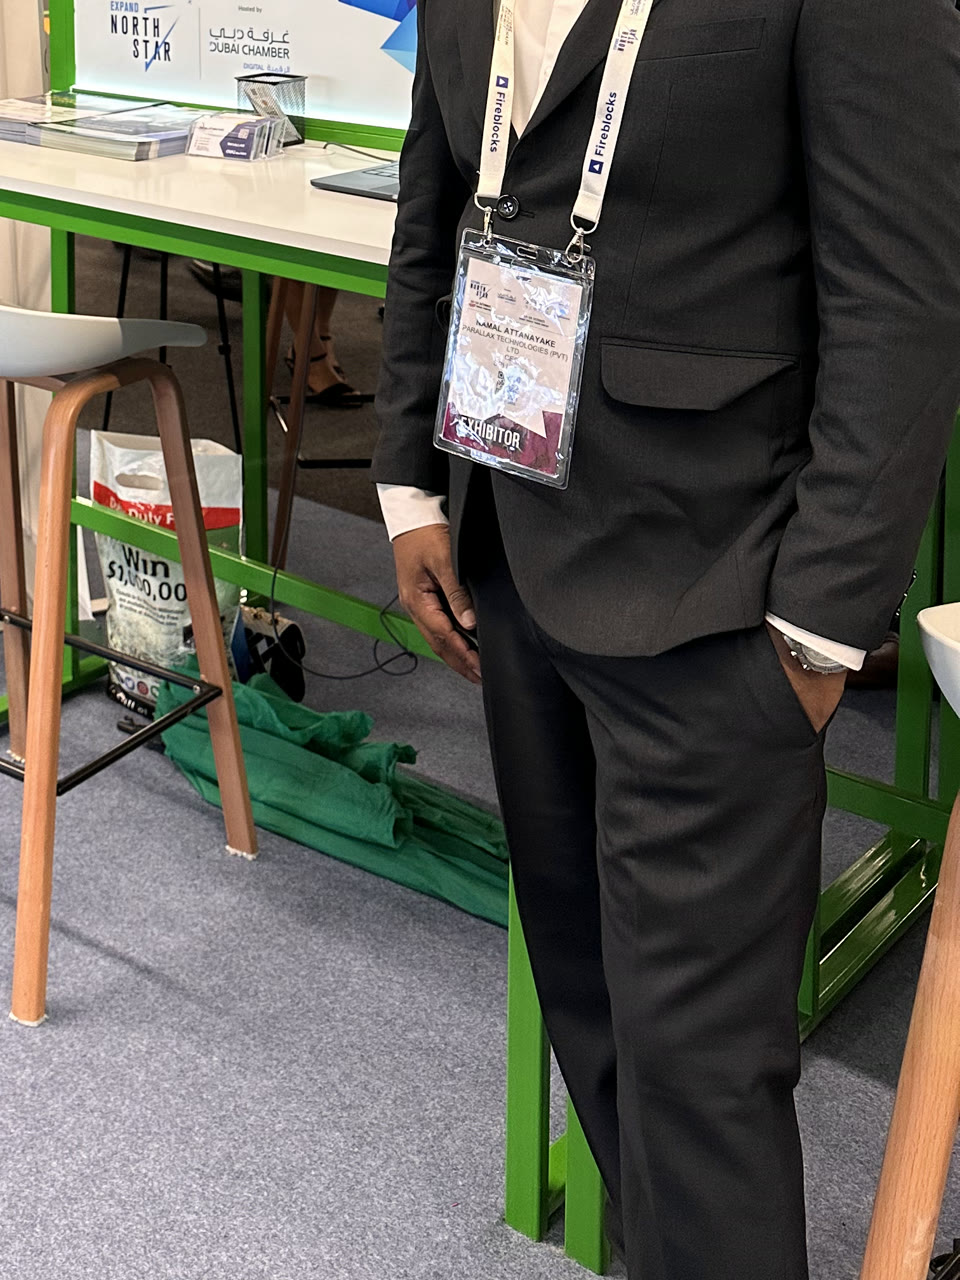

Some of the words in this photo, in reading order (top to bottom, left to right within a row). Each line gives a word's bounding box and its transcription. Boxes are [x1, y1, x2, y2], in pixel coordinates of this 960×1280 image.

[109, 0, 140, 14] EXPAND
[238, 5, 256, 13] Hosted
[109, 14, 161, 38] NORTH
[132, 38, 173, 63] STAR
[209, 41, 240, 55] DUBAI
[241, 44, 290, 60] CHAMBER
[243, 62, 265, 71] DIGITAL
[488, 90, 506, 154] Fireblocks
[595, 90, 618, 157] Fireblocks
[462, 324, 497, 345] PARALLAX
[496, 331, 549, 357] TECHNOLOGIES
[503, 326, 557, 348] ATTANAYAKE
[458, 415, 522, 451] EXHIBITOR
[121, 544, 171, 579] Win
